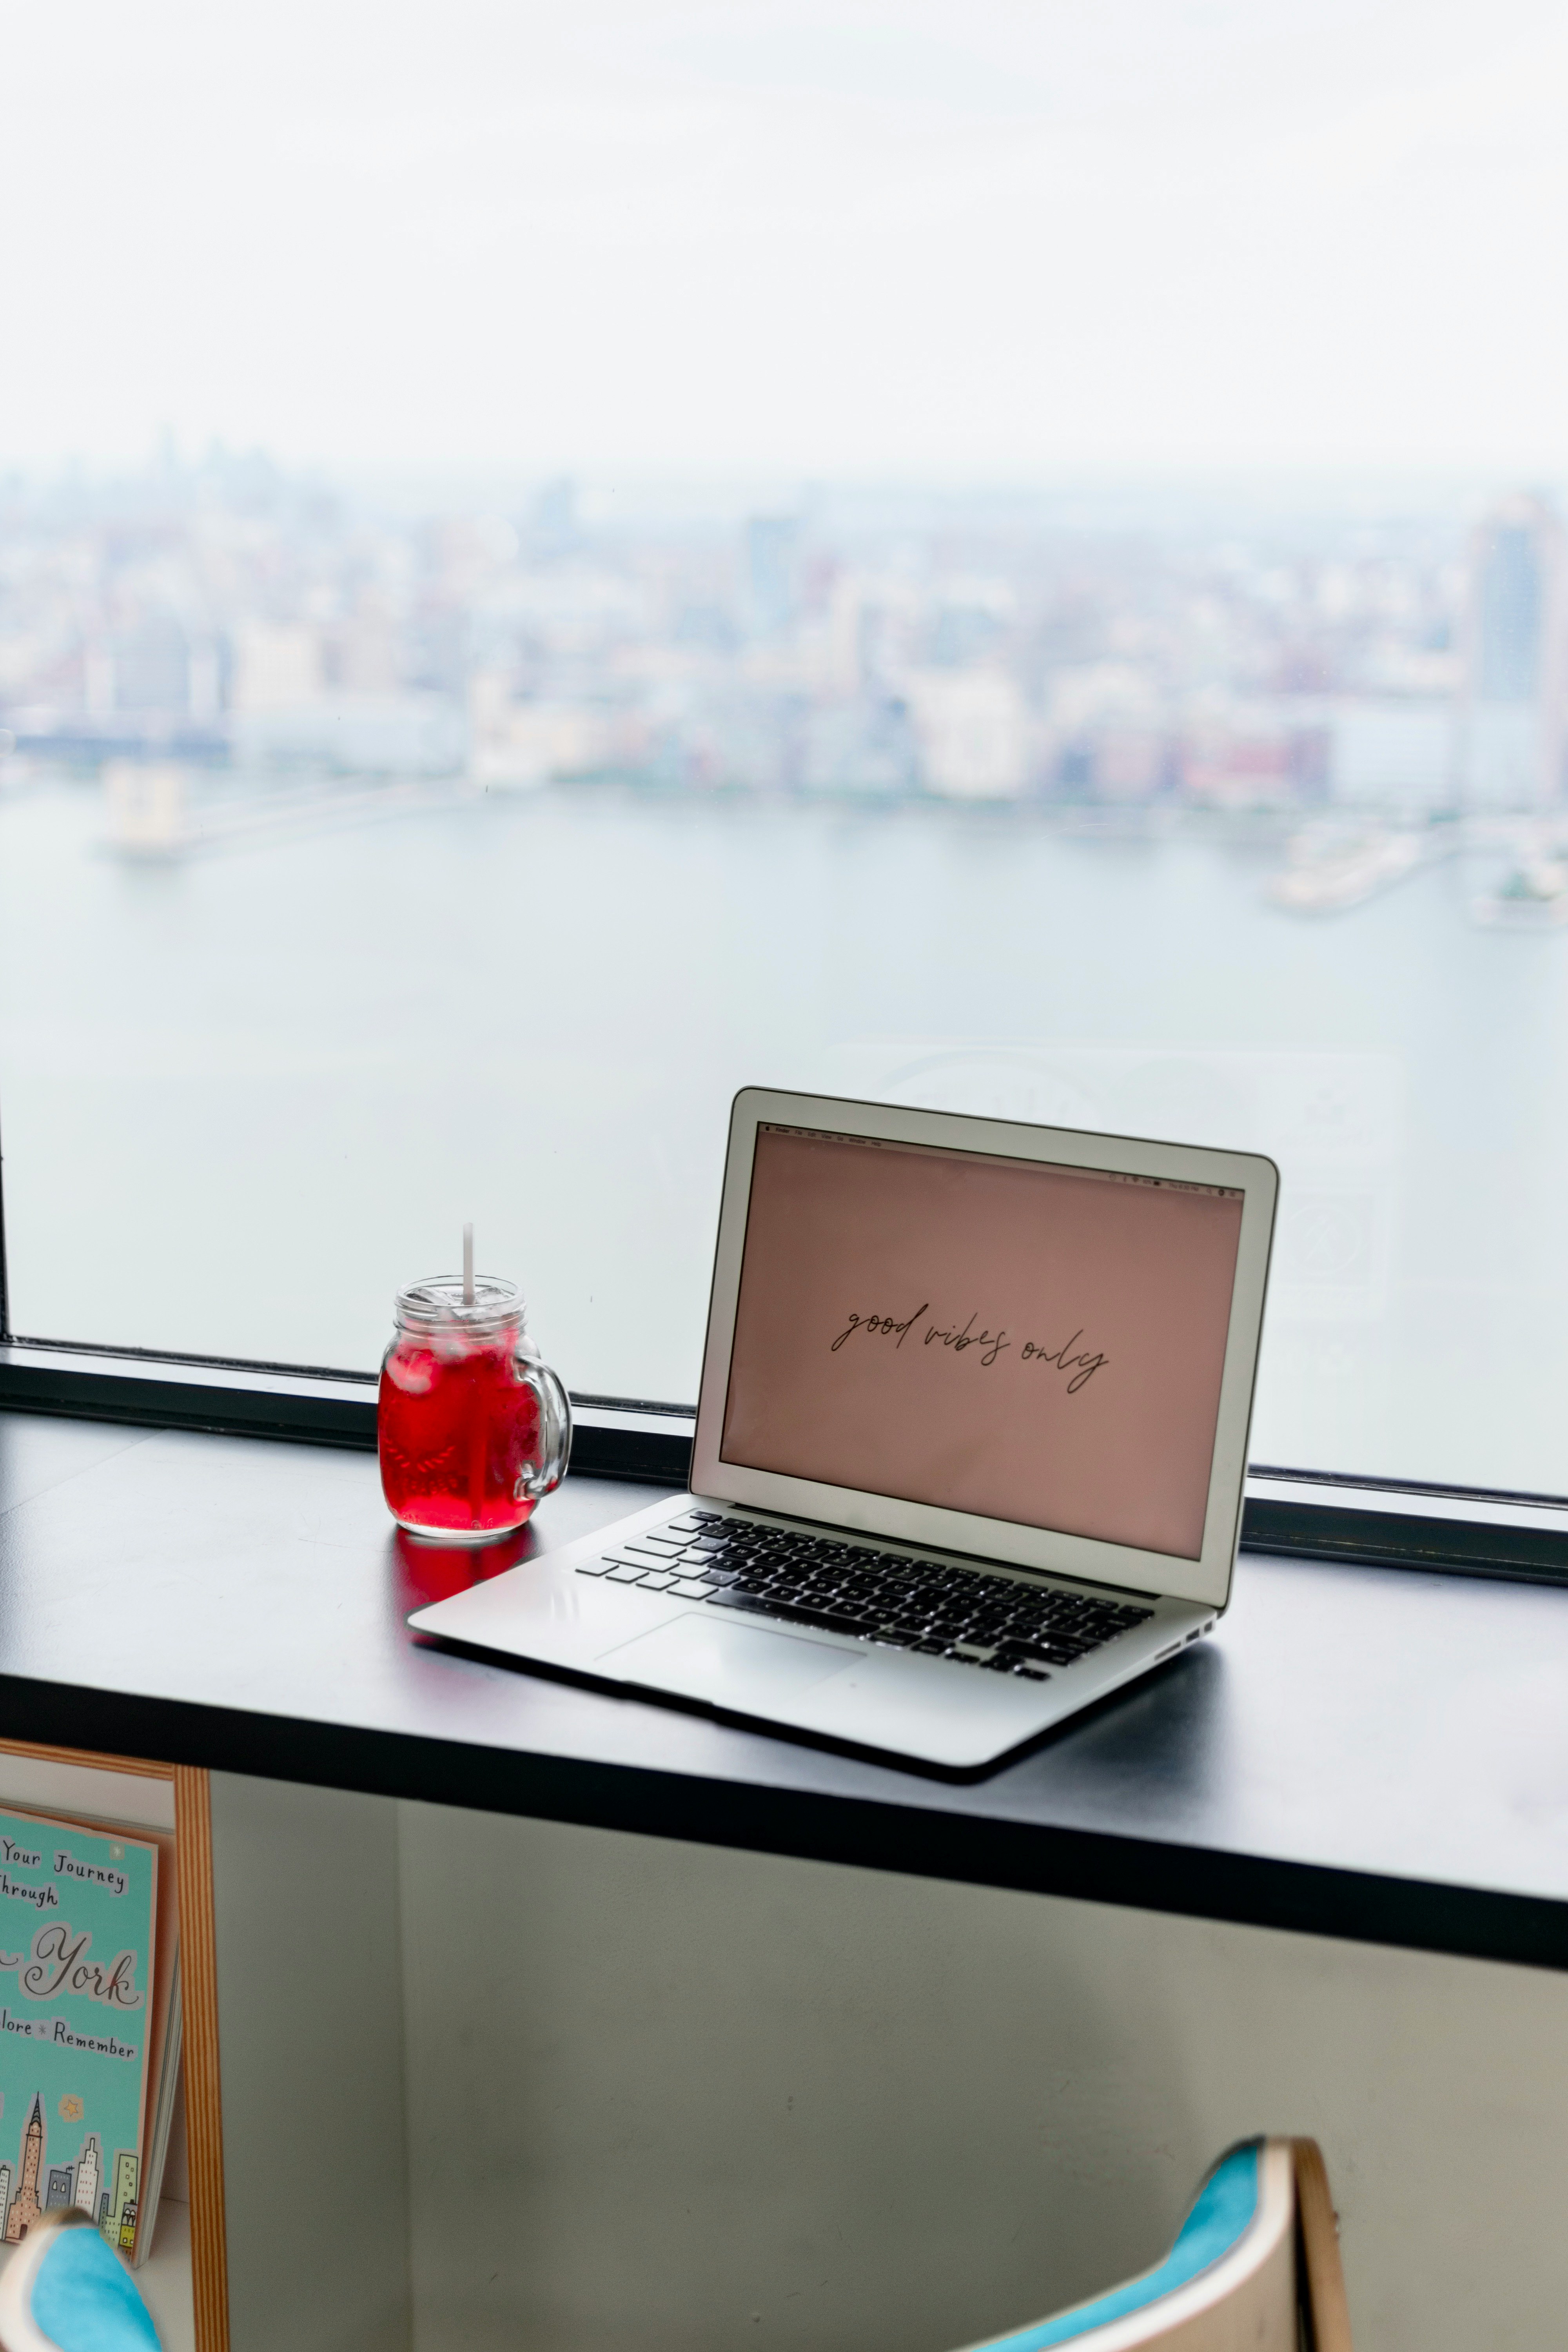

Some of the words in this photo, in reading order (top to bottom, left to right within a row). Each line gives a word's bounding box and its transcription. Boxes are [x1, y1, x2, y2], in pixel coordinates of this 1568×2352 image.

[831, 1303, 929, 1352] good
[924, 1312, 1011, 1366] vibes
[1021, 1329, 1109, 1394] only
[0, 1875, 58, 1907] hrough
[3, 1840, 40, 1864] Your
[54, 1855, 123, 1893] Journey
[25, 1927, 139, 2004] York
[0, 2009, 31, 2034] lore
[54, 2022, 134, 2057] Remember
